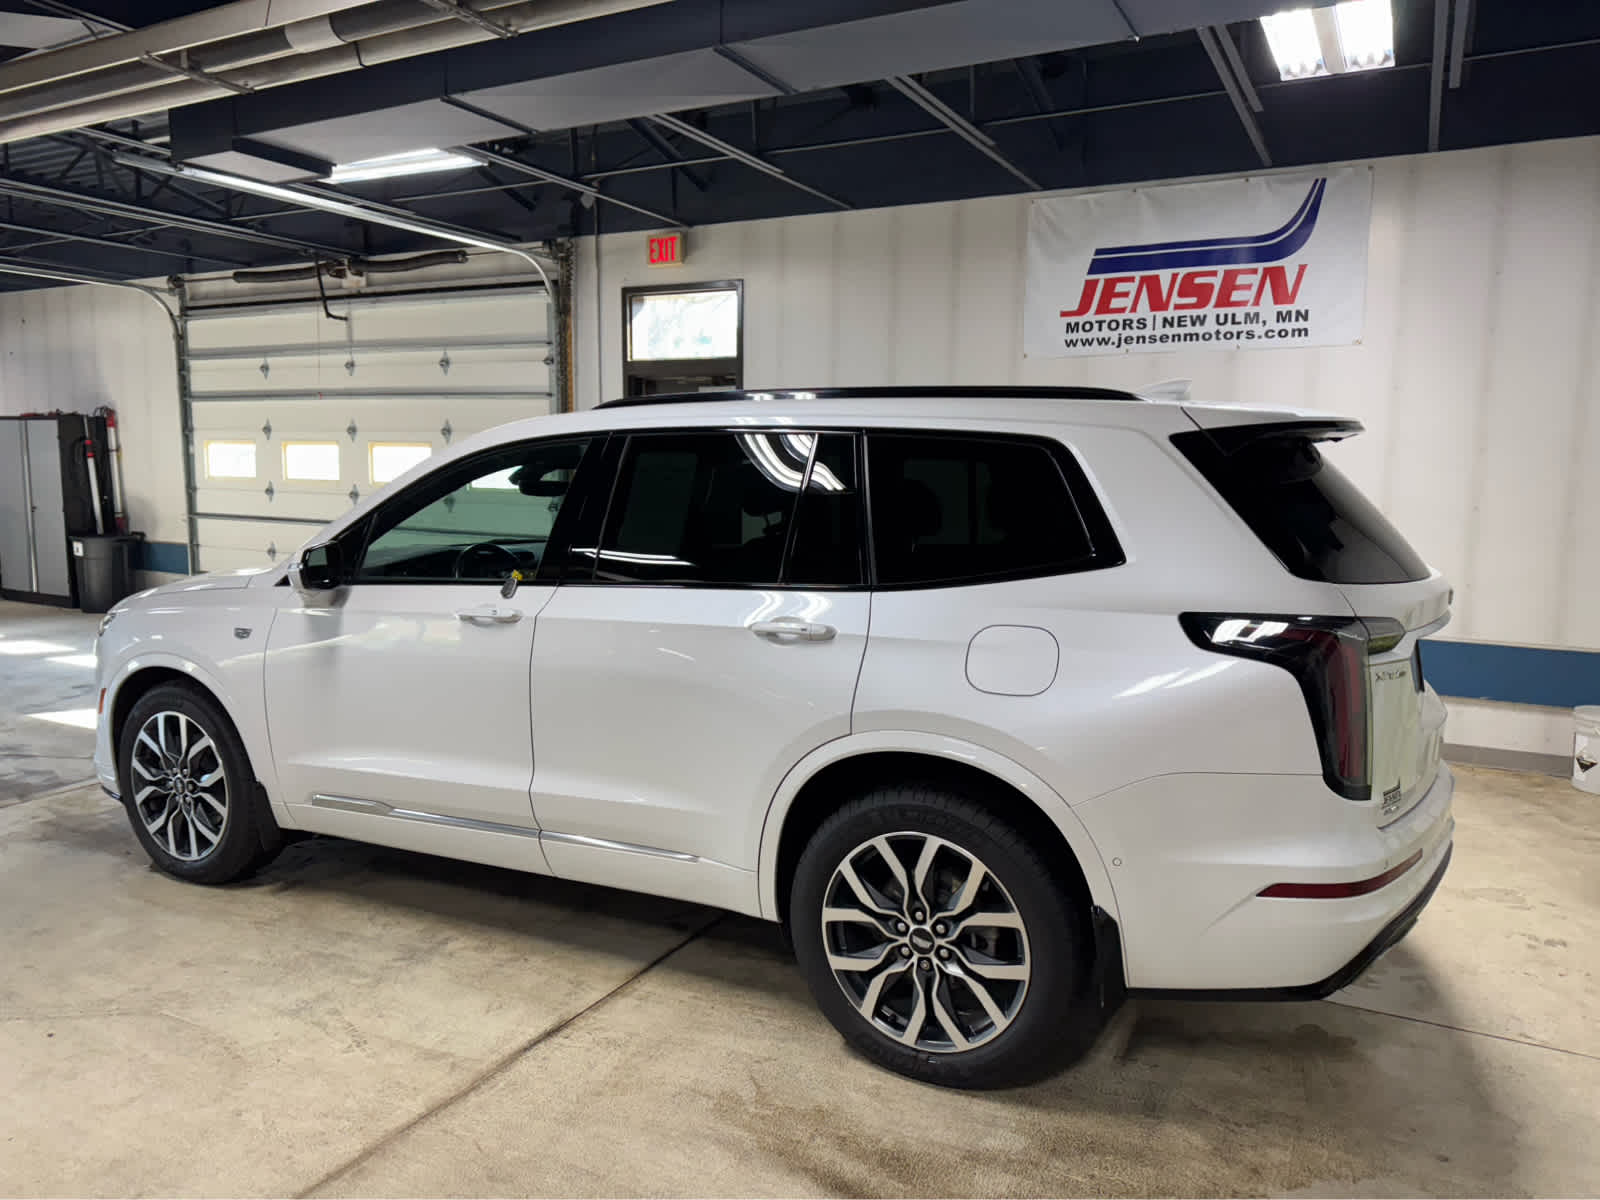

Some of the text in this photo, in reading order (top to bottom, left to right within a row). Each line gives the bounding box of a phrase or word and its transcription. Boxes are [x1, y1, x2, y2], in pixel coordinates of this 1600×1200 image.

[649, 236, 678, 264] EXIT
[1060, 264, 1308, 318] JENSEN
[1065, 309, 1309, 334] MOTORS NEW ULM, MN
[1064, 327, 1309, 349] www.jensenmotors.com
